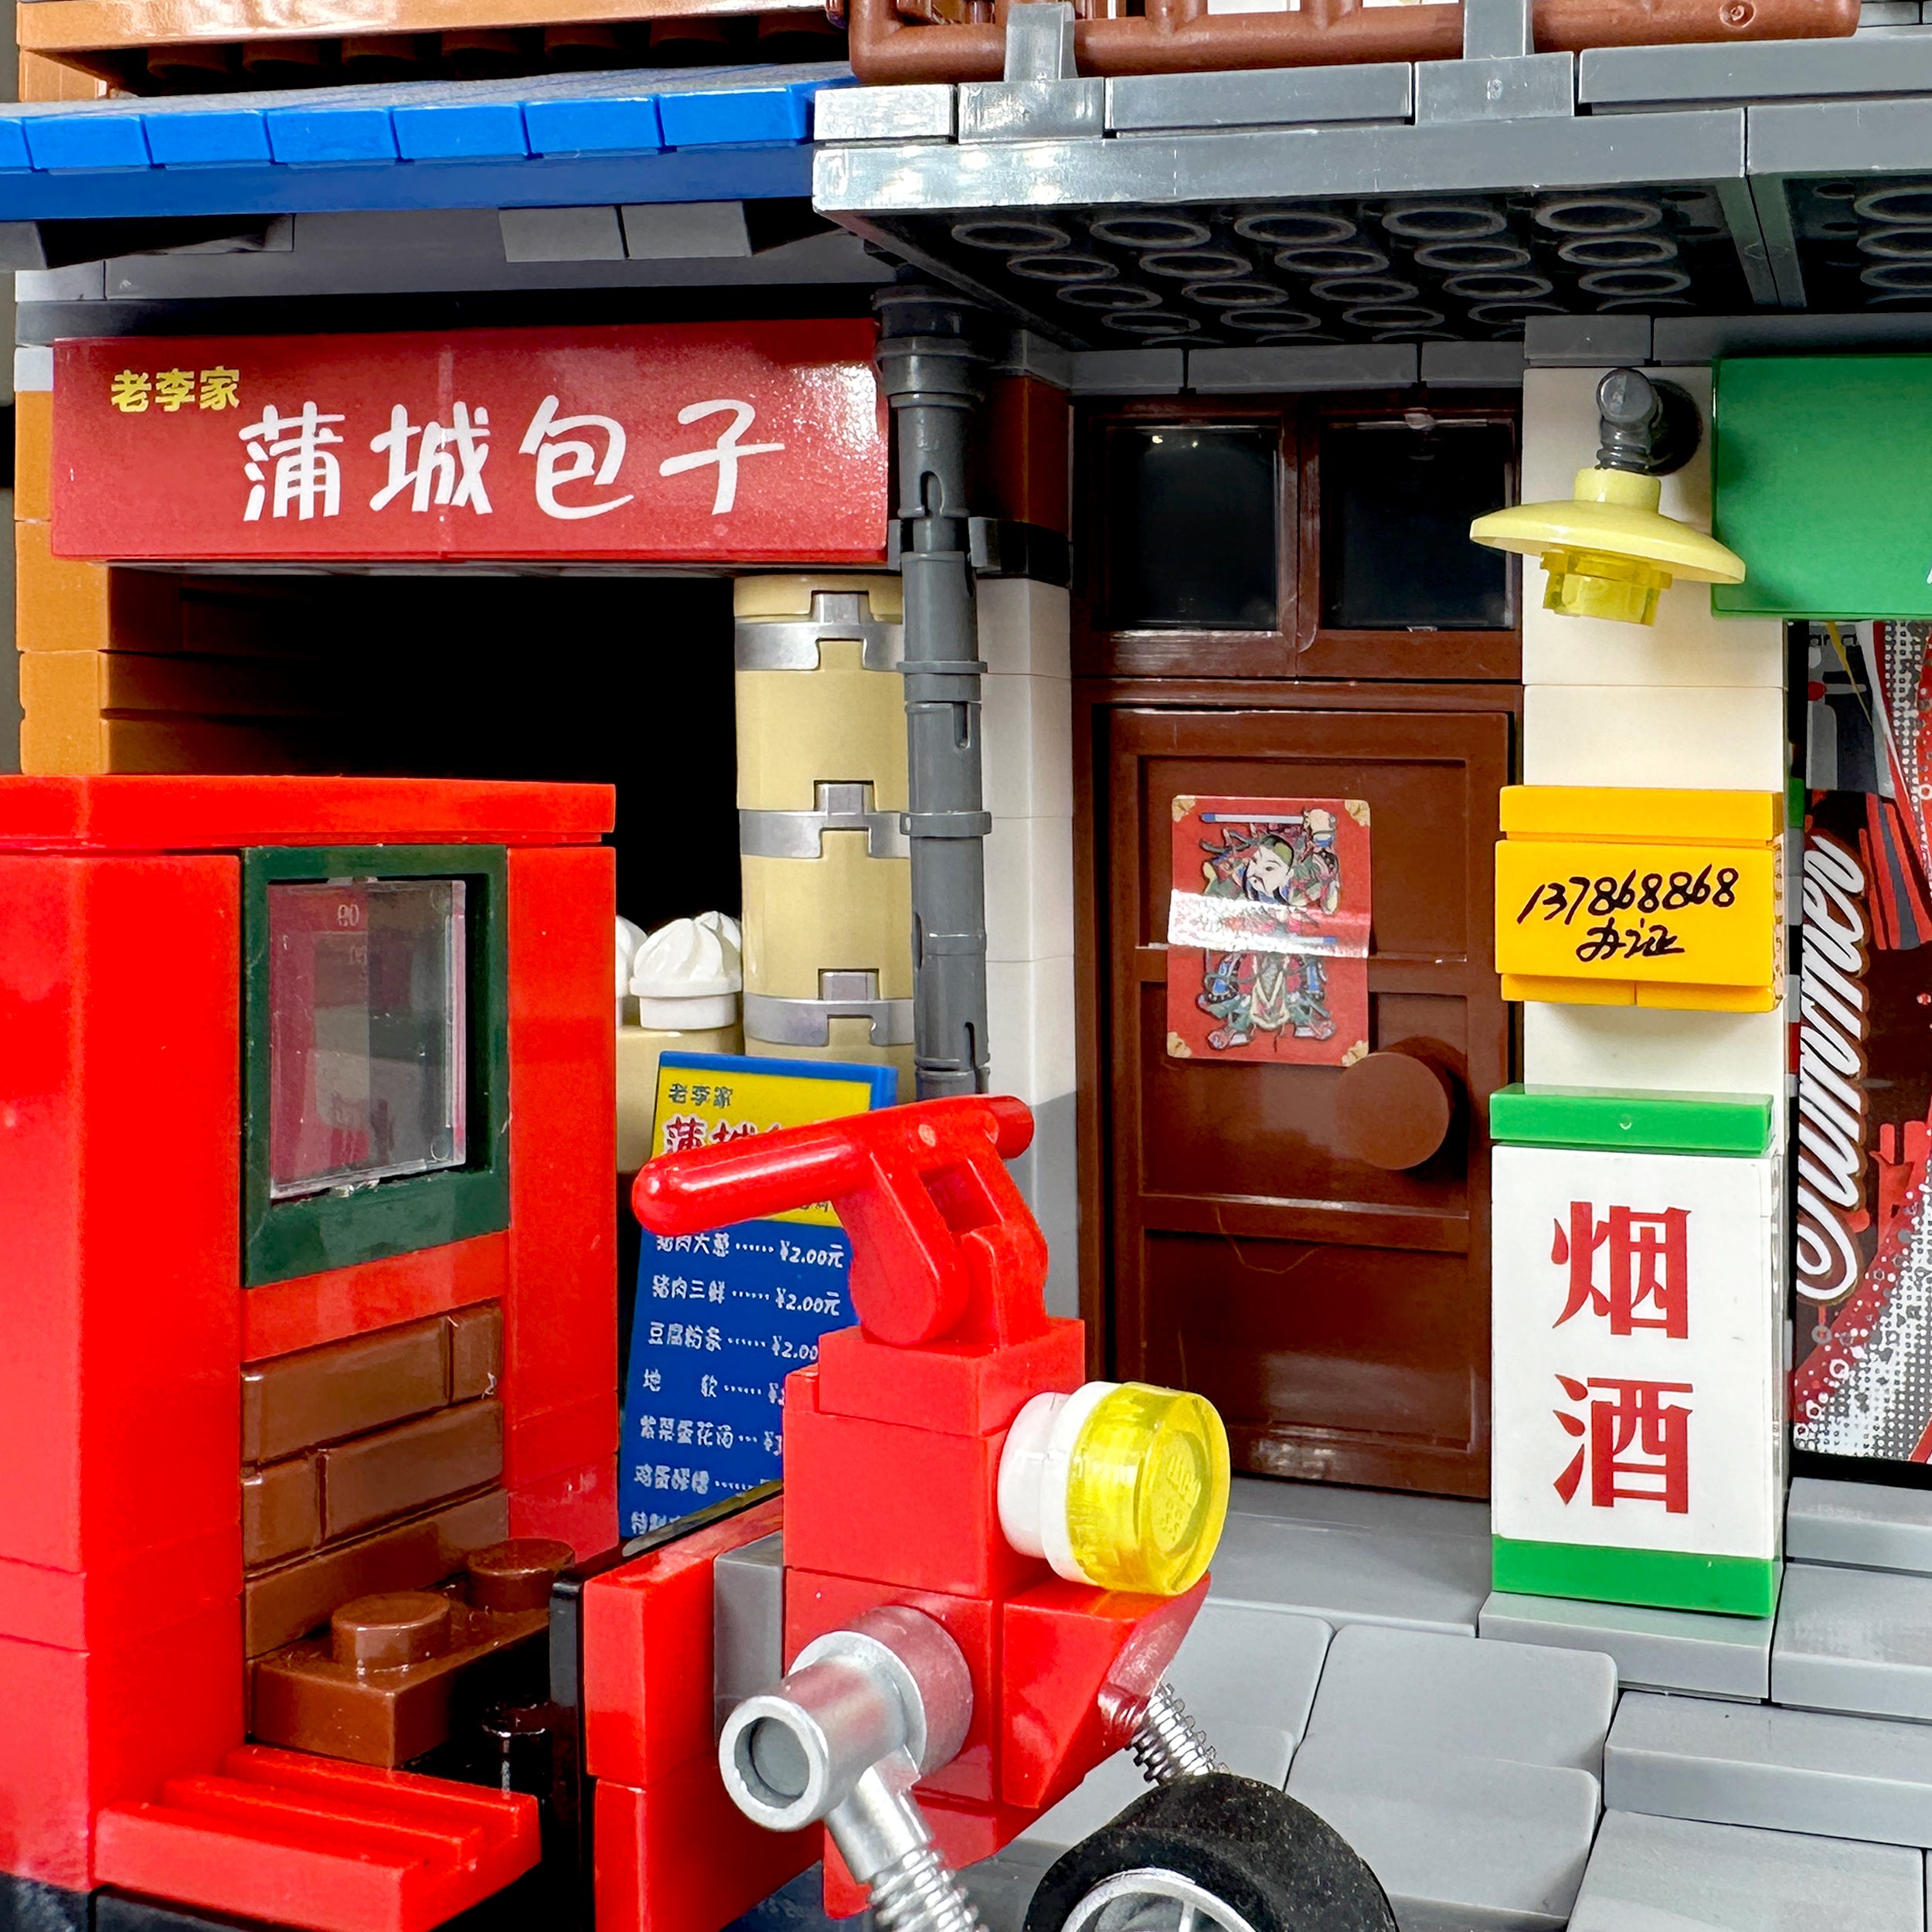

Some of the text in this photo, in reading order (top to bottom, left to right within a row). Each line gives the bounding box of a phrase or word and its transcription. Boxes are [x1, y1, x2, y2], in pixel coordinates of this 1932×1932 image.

[111, 366, 240, 413] 老李家
[238, 395, 785, 522] 蒲城包子
[1517, 863, 1739, 924] 137868868
[668, 1083, 733, 1109] 老李家
[1551, 1201, 1693, 1514] 烟酒
